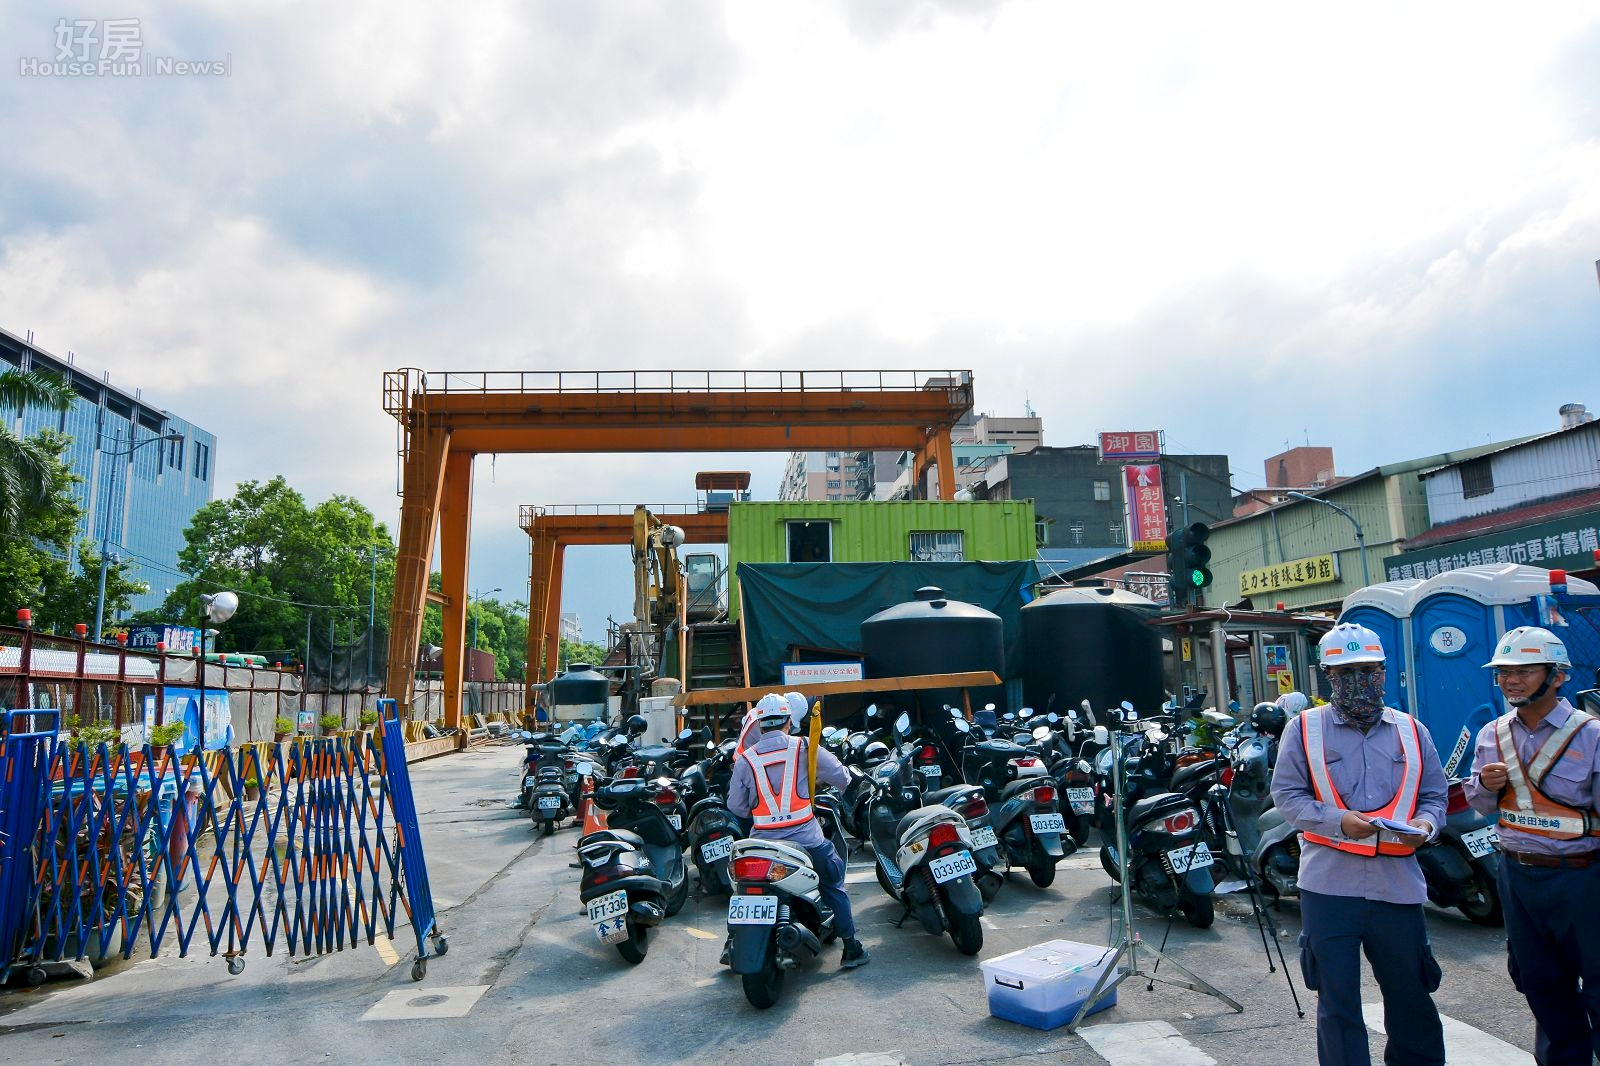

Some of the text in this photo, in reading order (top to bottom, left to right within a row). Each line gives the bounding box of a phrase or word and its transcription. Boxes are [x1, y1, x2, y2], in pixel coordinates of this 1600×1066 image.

[1106, 433, 1154, 452] 御園
[1140, 487, 1165, 540] 創作料理
[1388, 526, 1600, 582] 捷運頂埔新站特區都市更新籌備
